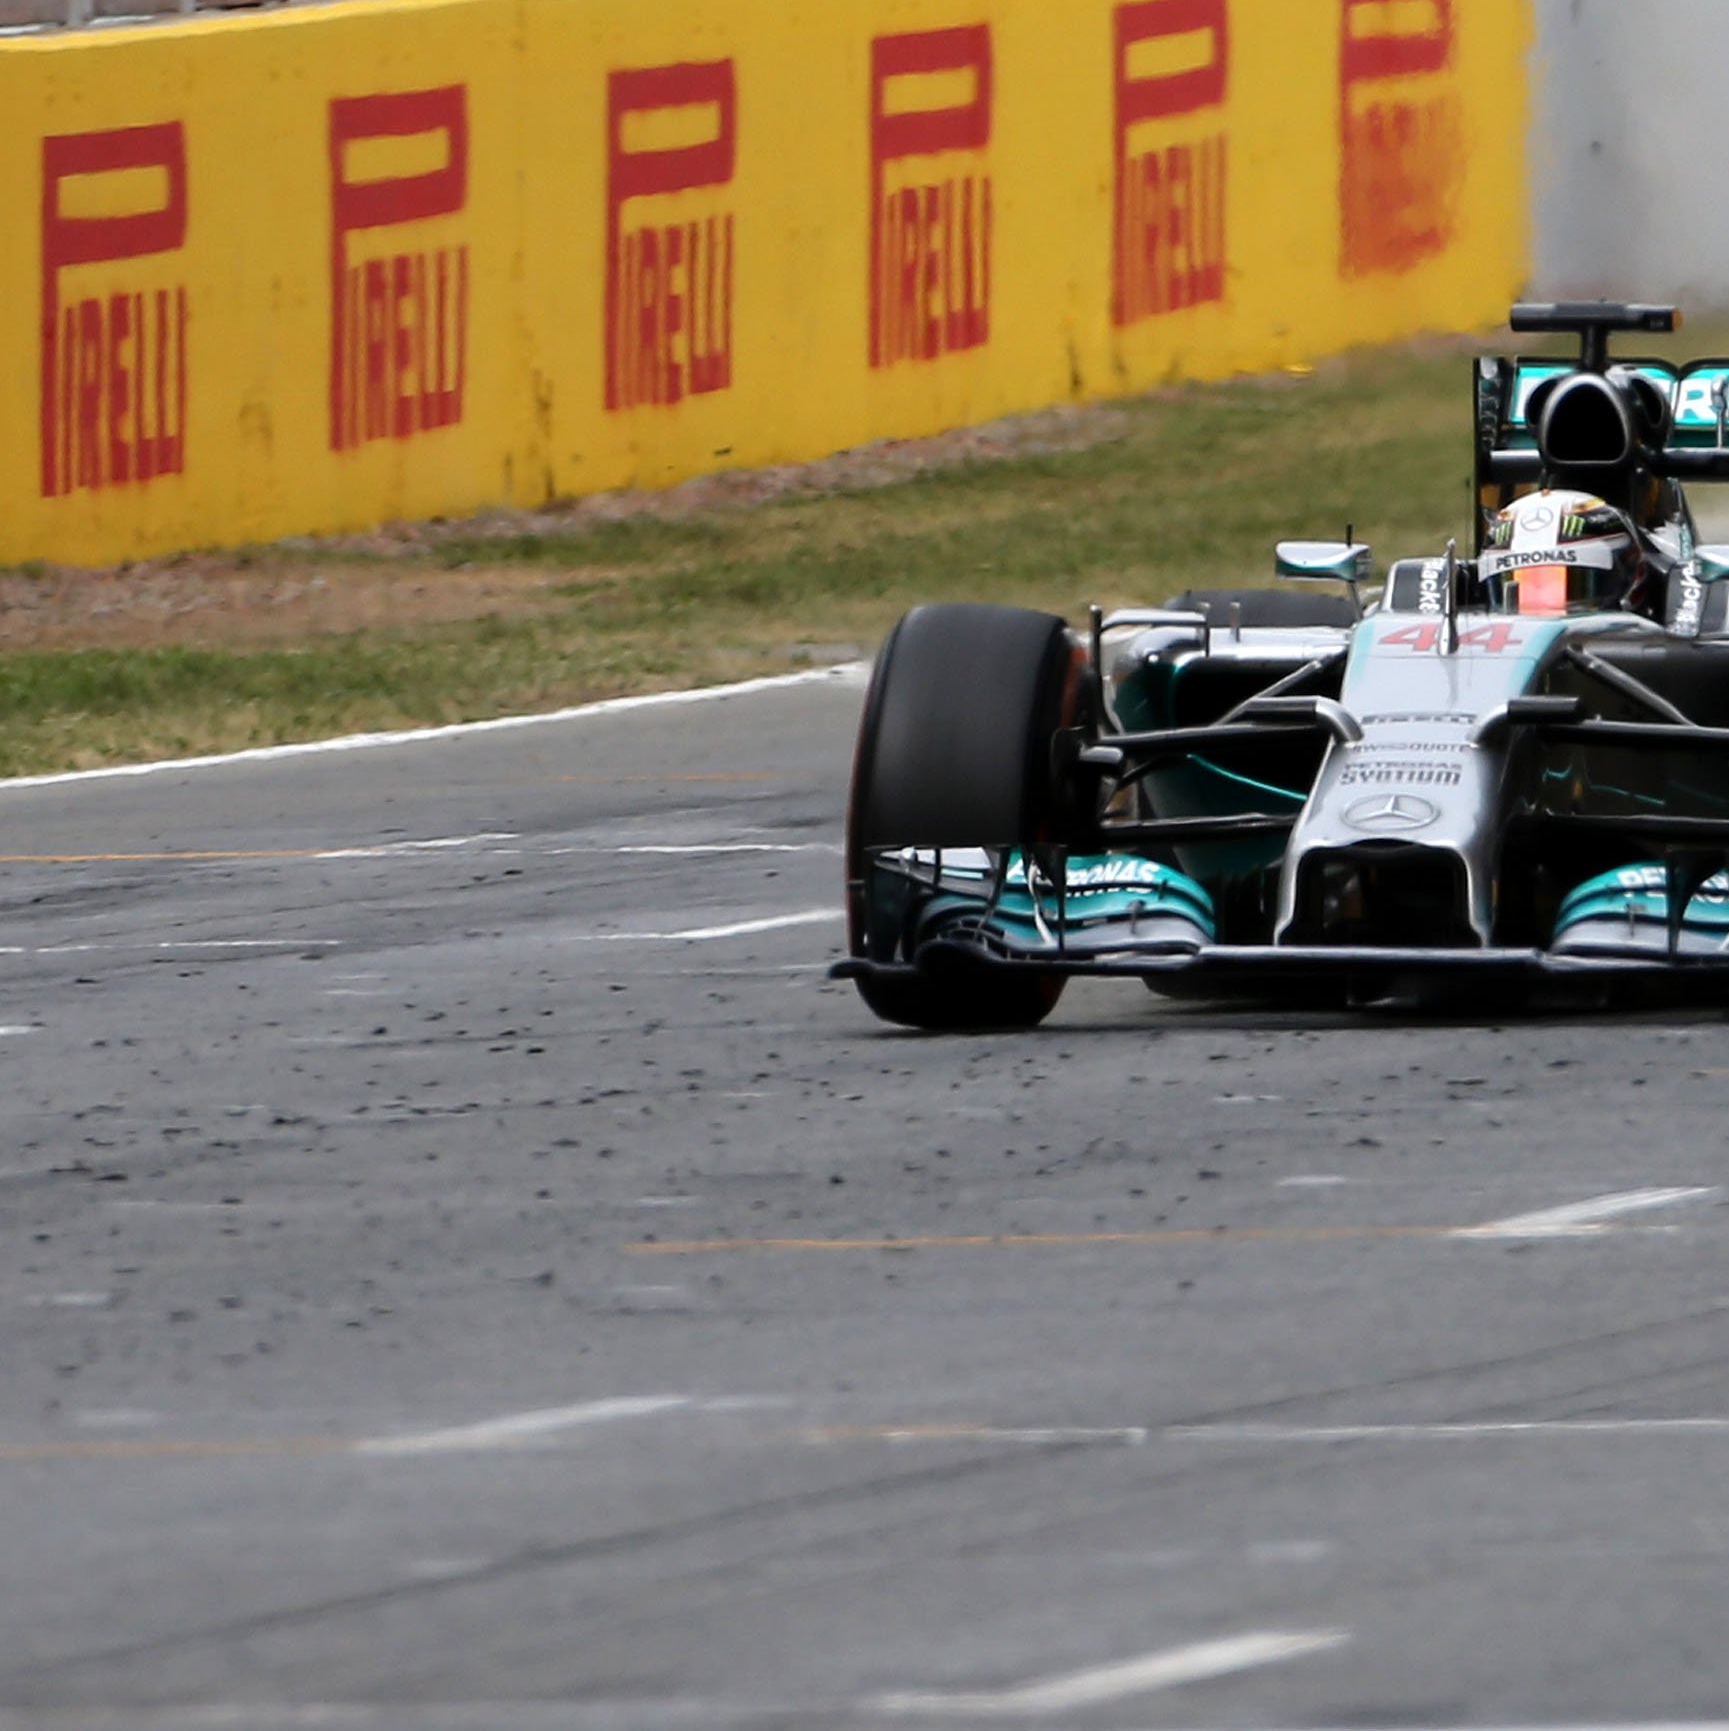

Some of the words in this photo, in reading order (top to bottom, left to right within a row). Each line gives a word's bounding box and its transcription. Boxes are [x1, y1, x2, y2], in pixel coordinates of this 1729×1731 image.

[41, 120, 187, 499] PIRELLI
[328, 83, 468, 453] PIRELLI
[603, 57, 736, 412] PIRELLI
[869, 22, 993, 370] PIRELLI
[1379, 622, 1522, 653] 44
[1496, 550, 1577, 569] PETRONAS
